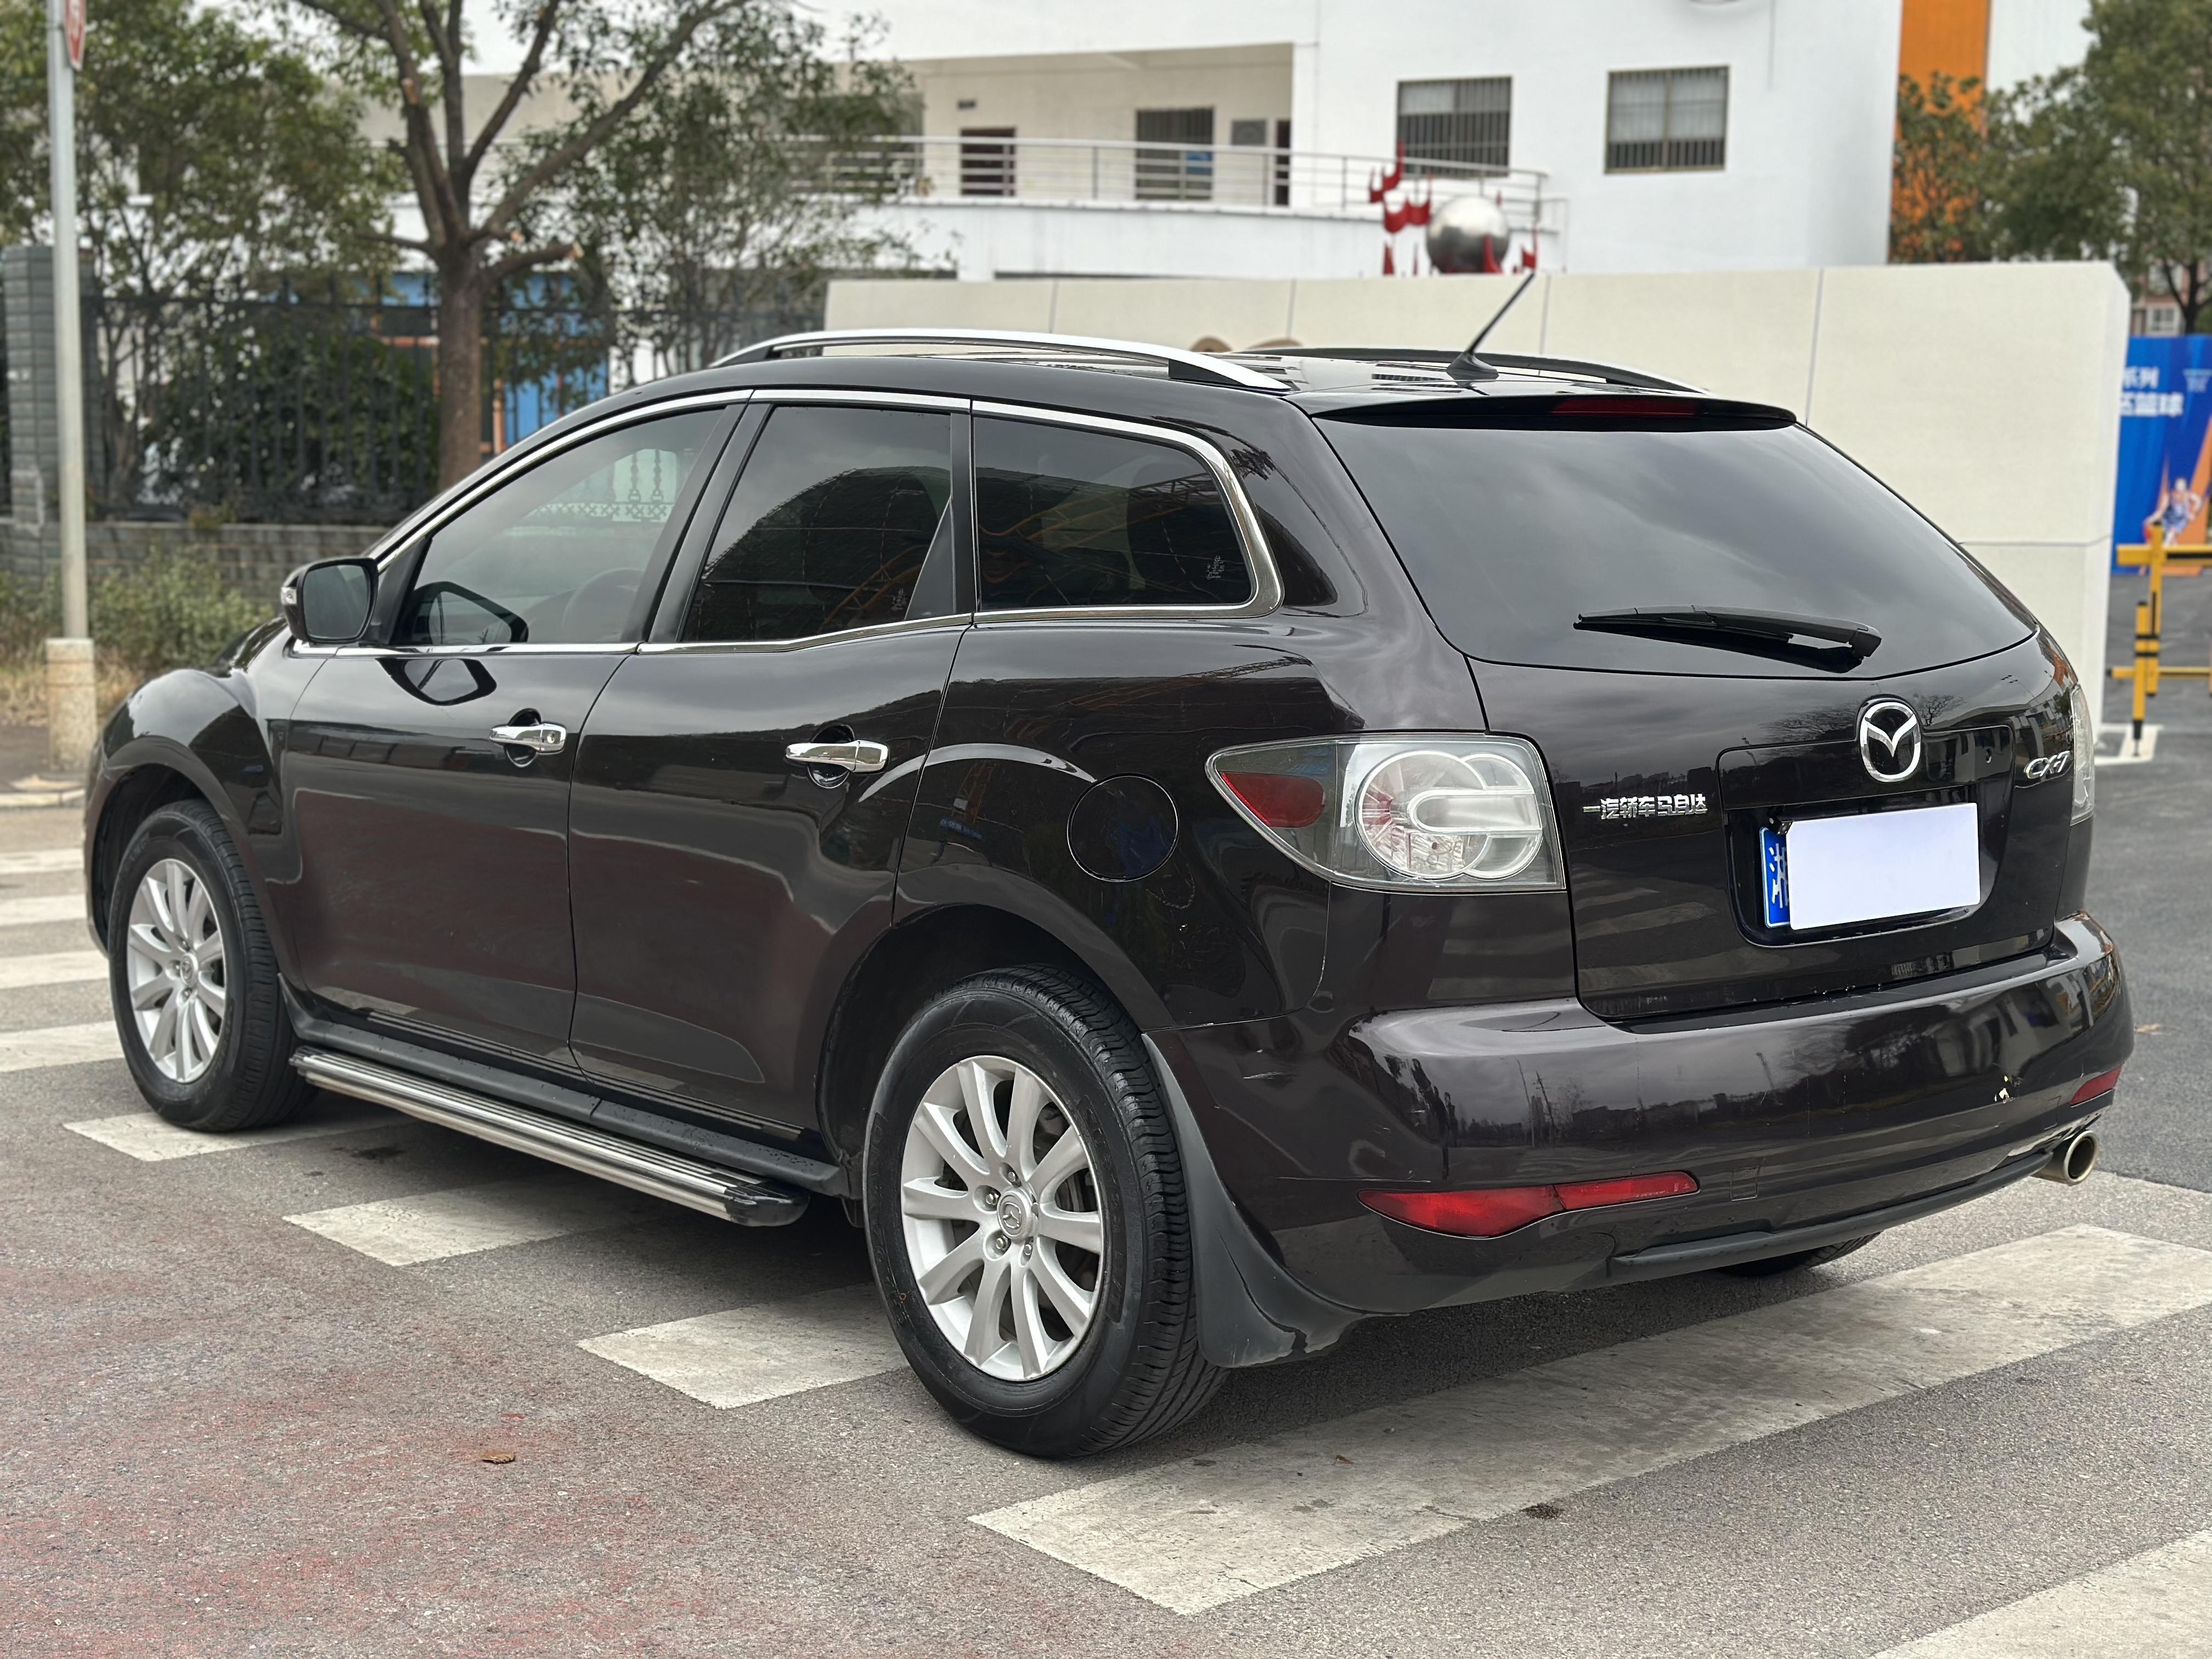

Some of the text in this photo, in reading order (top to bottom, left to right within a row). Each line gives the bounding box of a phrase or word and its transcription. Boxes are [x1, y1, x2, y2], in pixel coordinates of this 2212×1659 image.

[1583, 794, 1707, 820] 一汽轿车马自达
